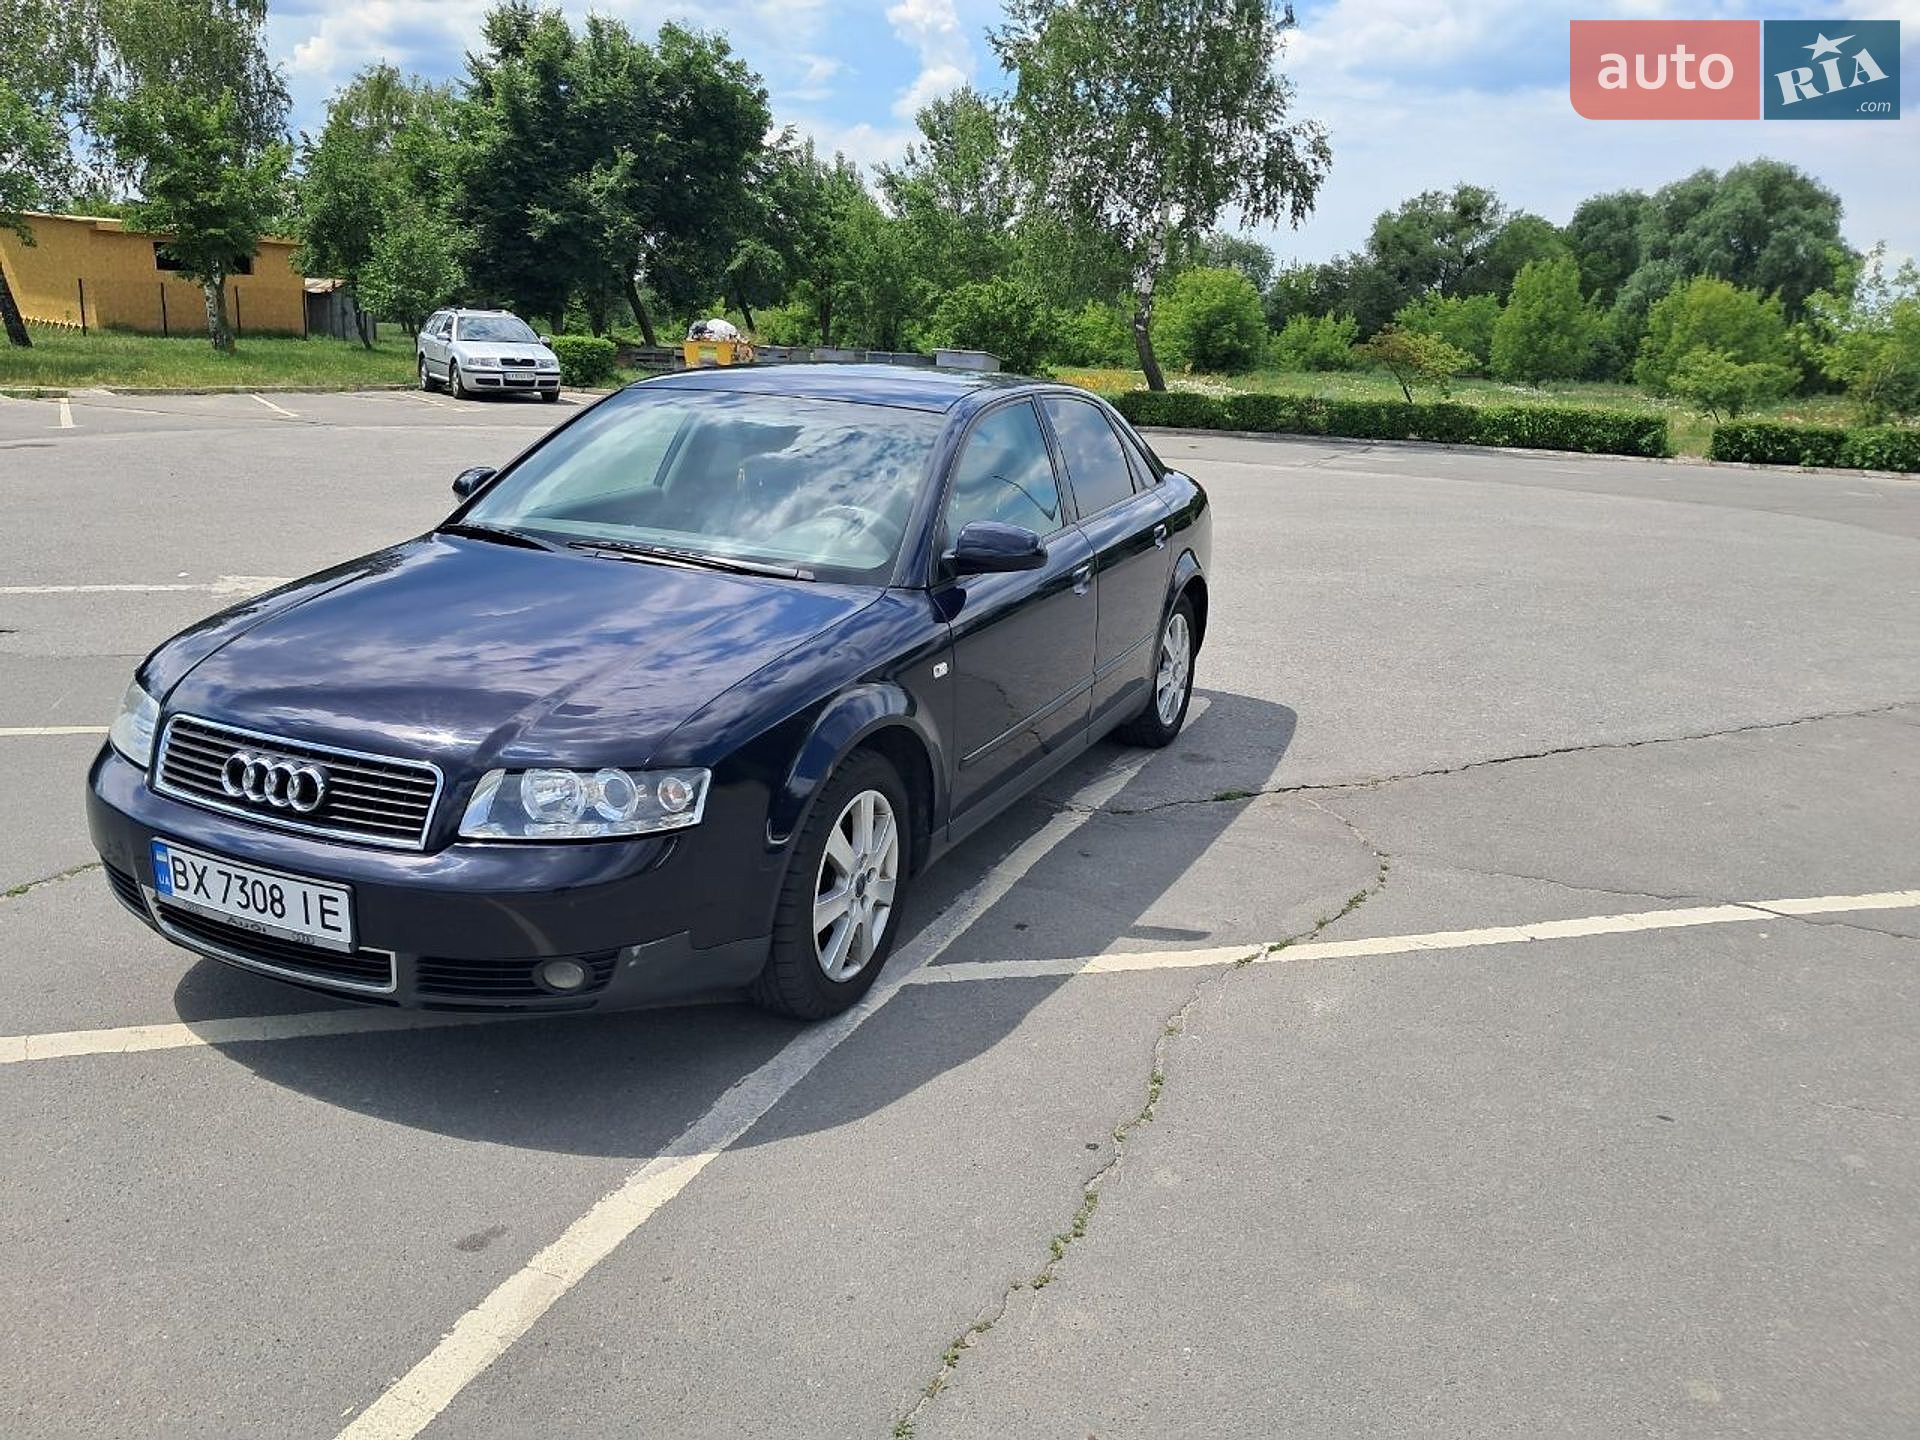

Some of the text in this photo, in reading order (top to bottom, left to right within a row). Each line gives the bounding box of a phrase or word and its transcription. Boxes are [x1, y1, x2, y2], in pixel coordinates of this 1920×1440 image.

[170, 855, 343, 933] BX 7308 IE
